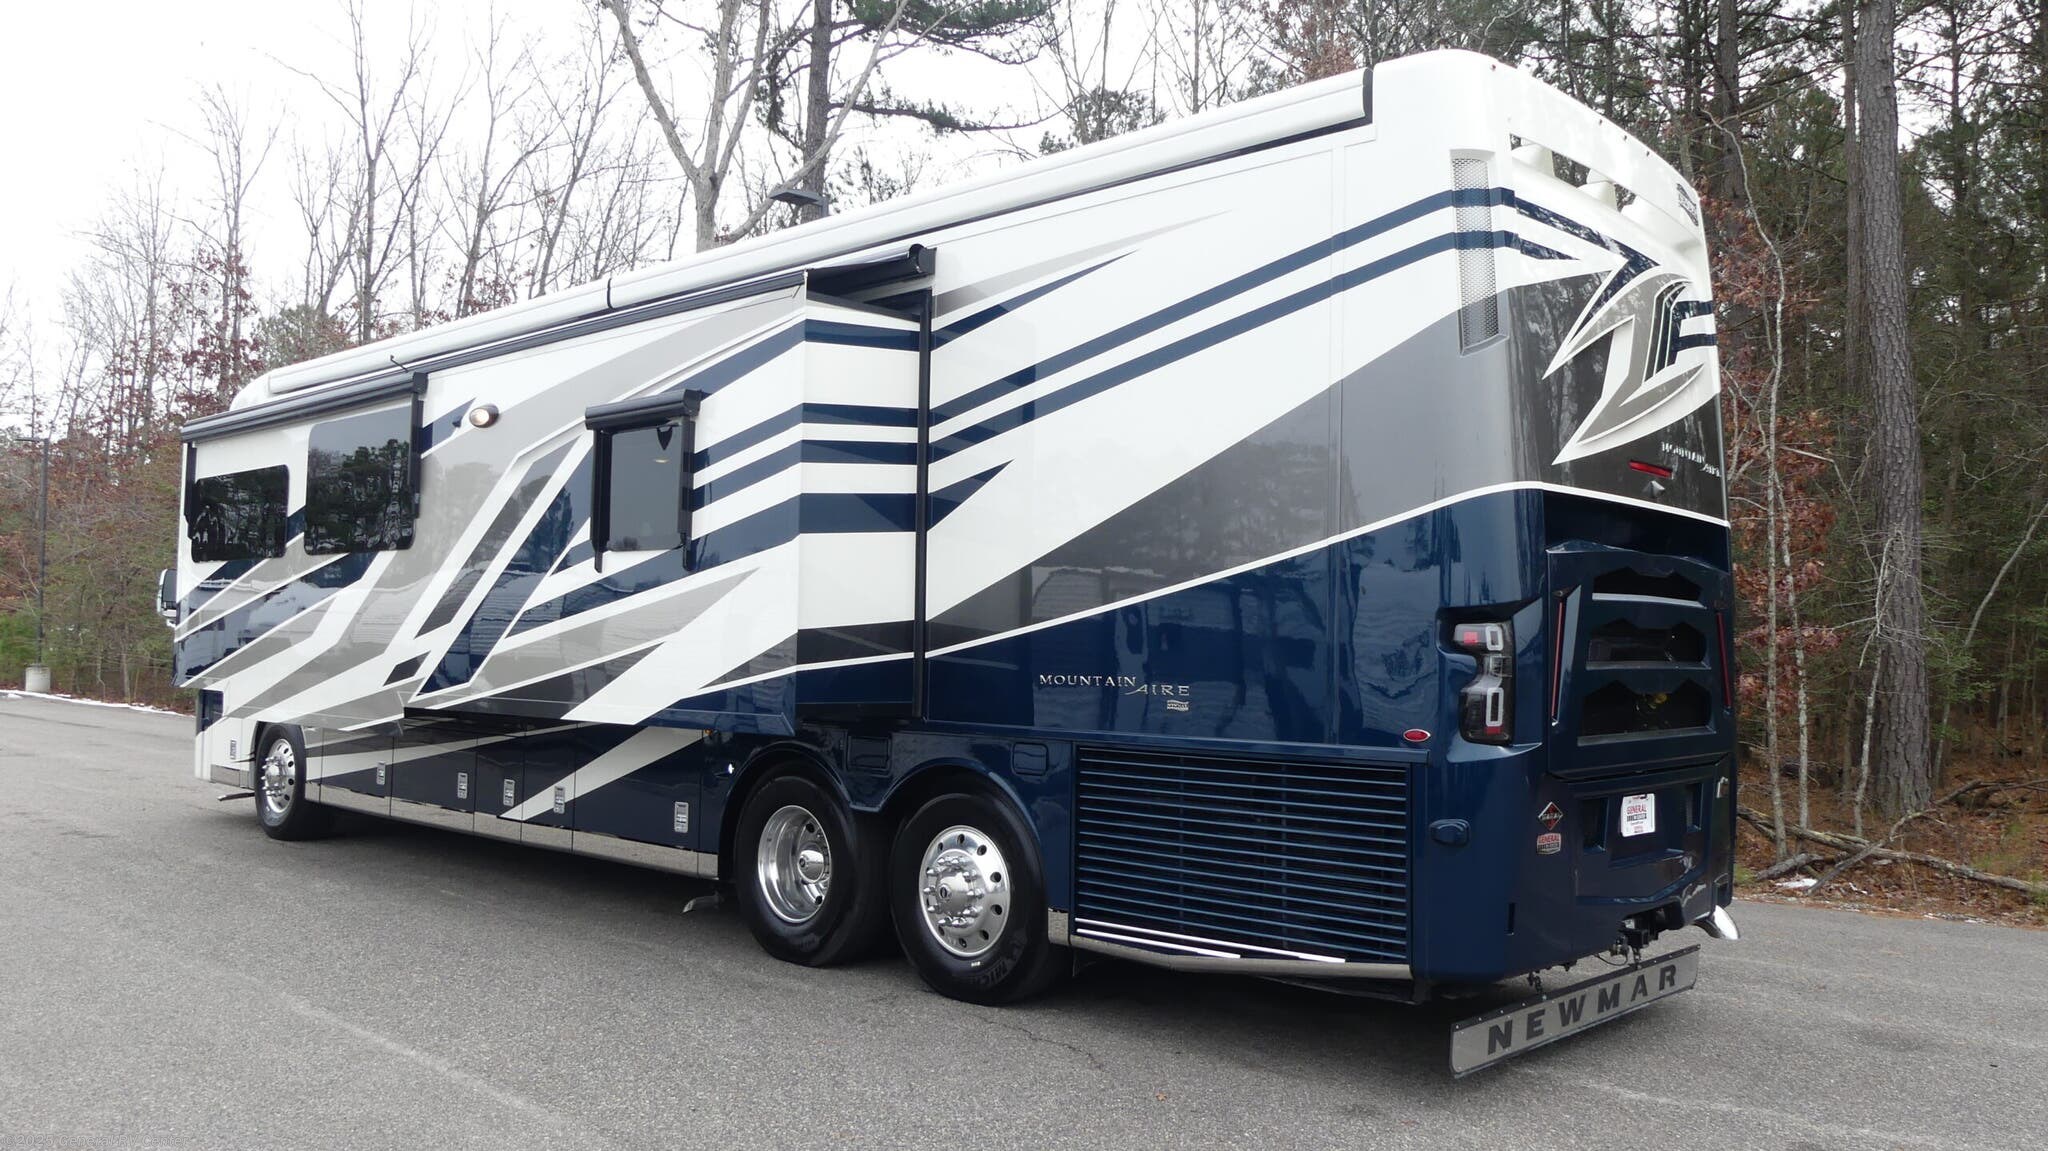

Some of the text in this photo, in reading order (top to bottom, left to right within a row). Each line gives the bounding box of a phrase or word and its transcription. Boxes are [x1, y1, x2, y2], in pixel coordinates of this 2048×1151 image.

[1040, 674, 1190, 696] MOUNTAIN AIRE
[1488, 964, 1677, 1055] NEWMAR
